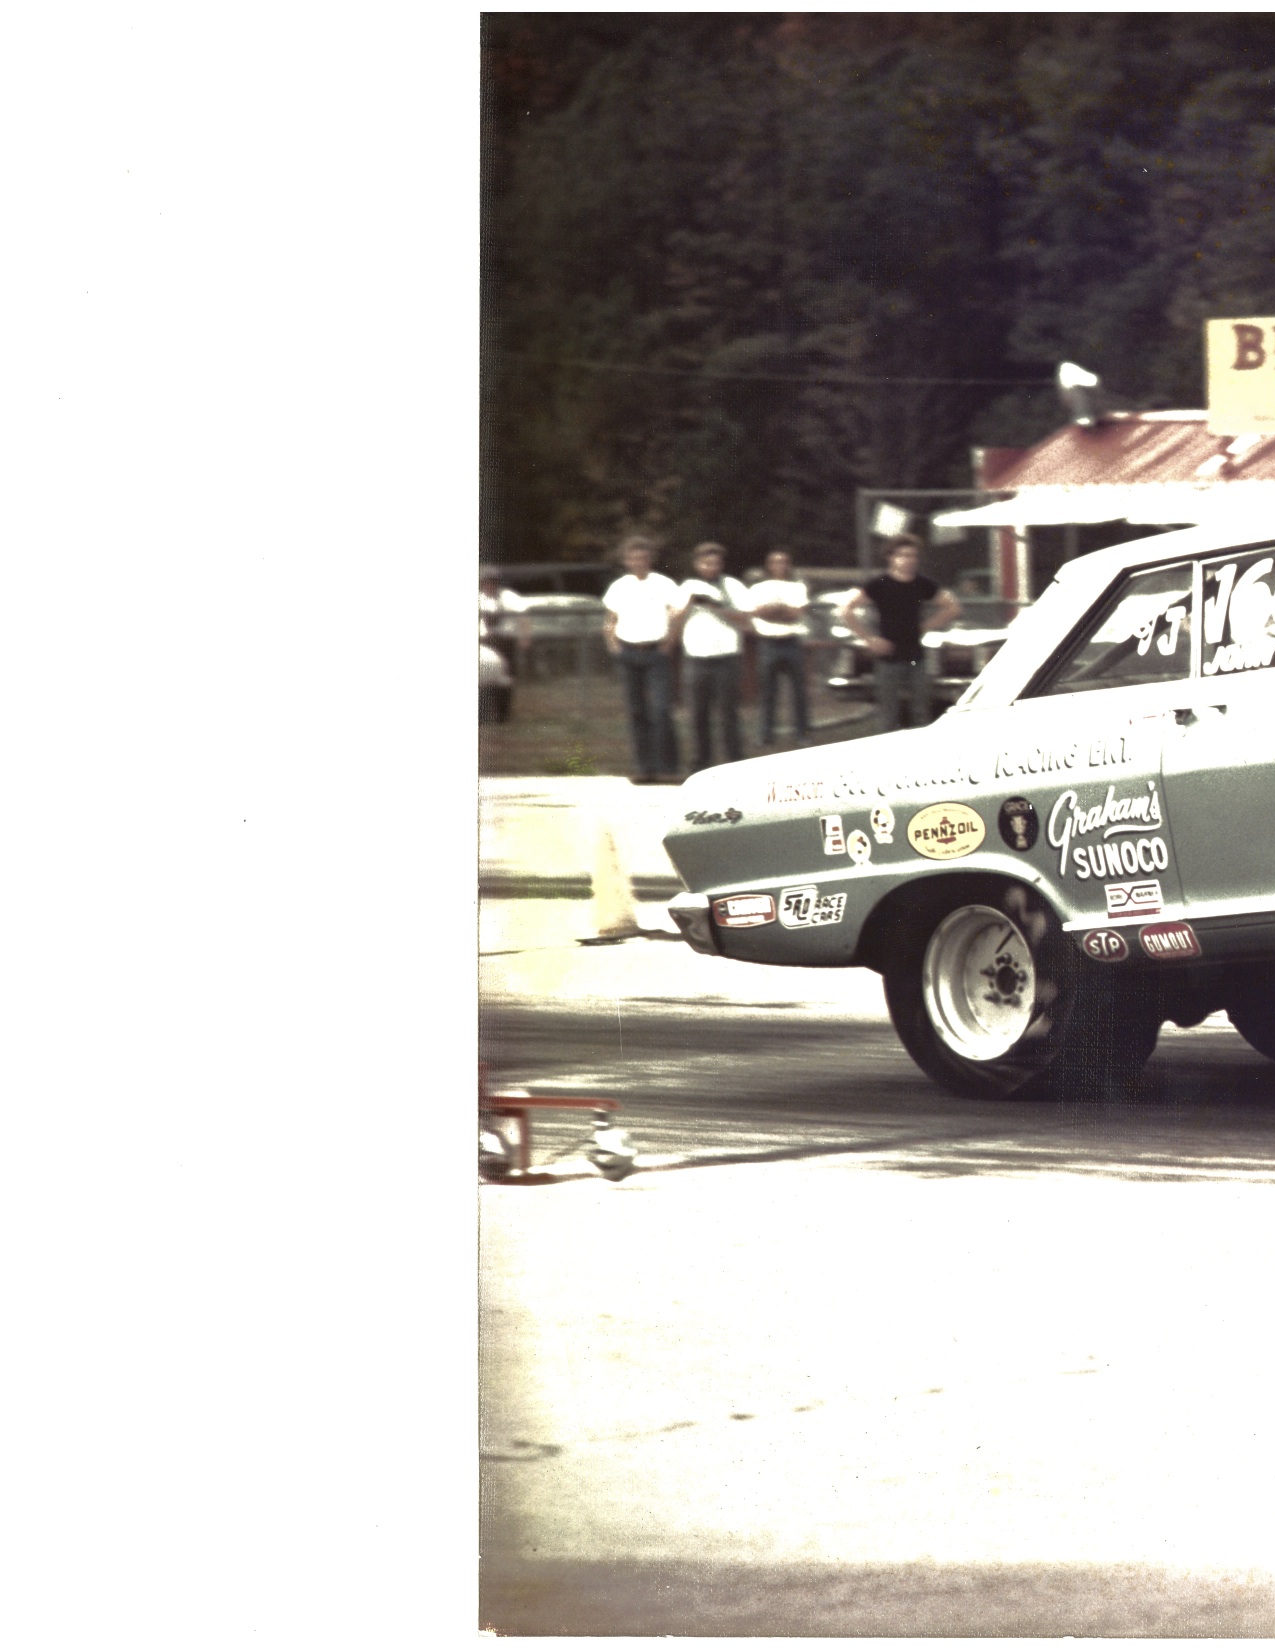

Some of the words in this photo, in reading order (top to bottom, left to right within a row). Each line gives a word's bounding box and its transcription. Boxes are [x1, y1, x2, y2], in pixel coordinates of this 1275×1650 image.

[914, 821, 979, 841] PENNZOIL
[1047, 781, 1163, 877] Graham's
[1073, 837, 1169, 879] SUNOCO
[1088, 932, 1121, 957] STP
[1143, 930, 1194, 953] GUMOUT
